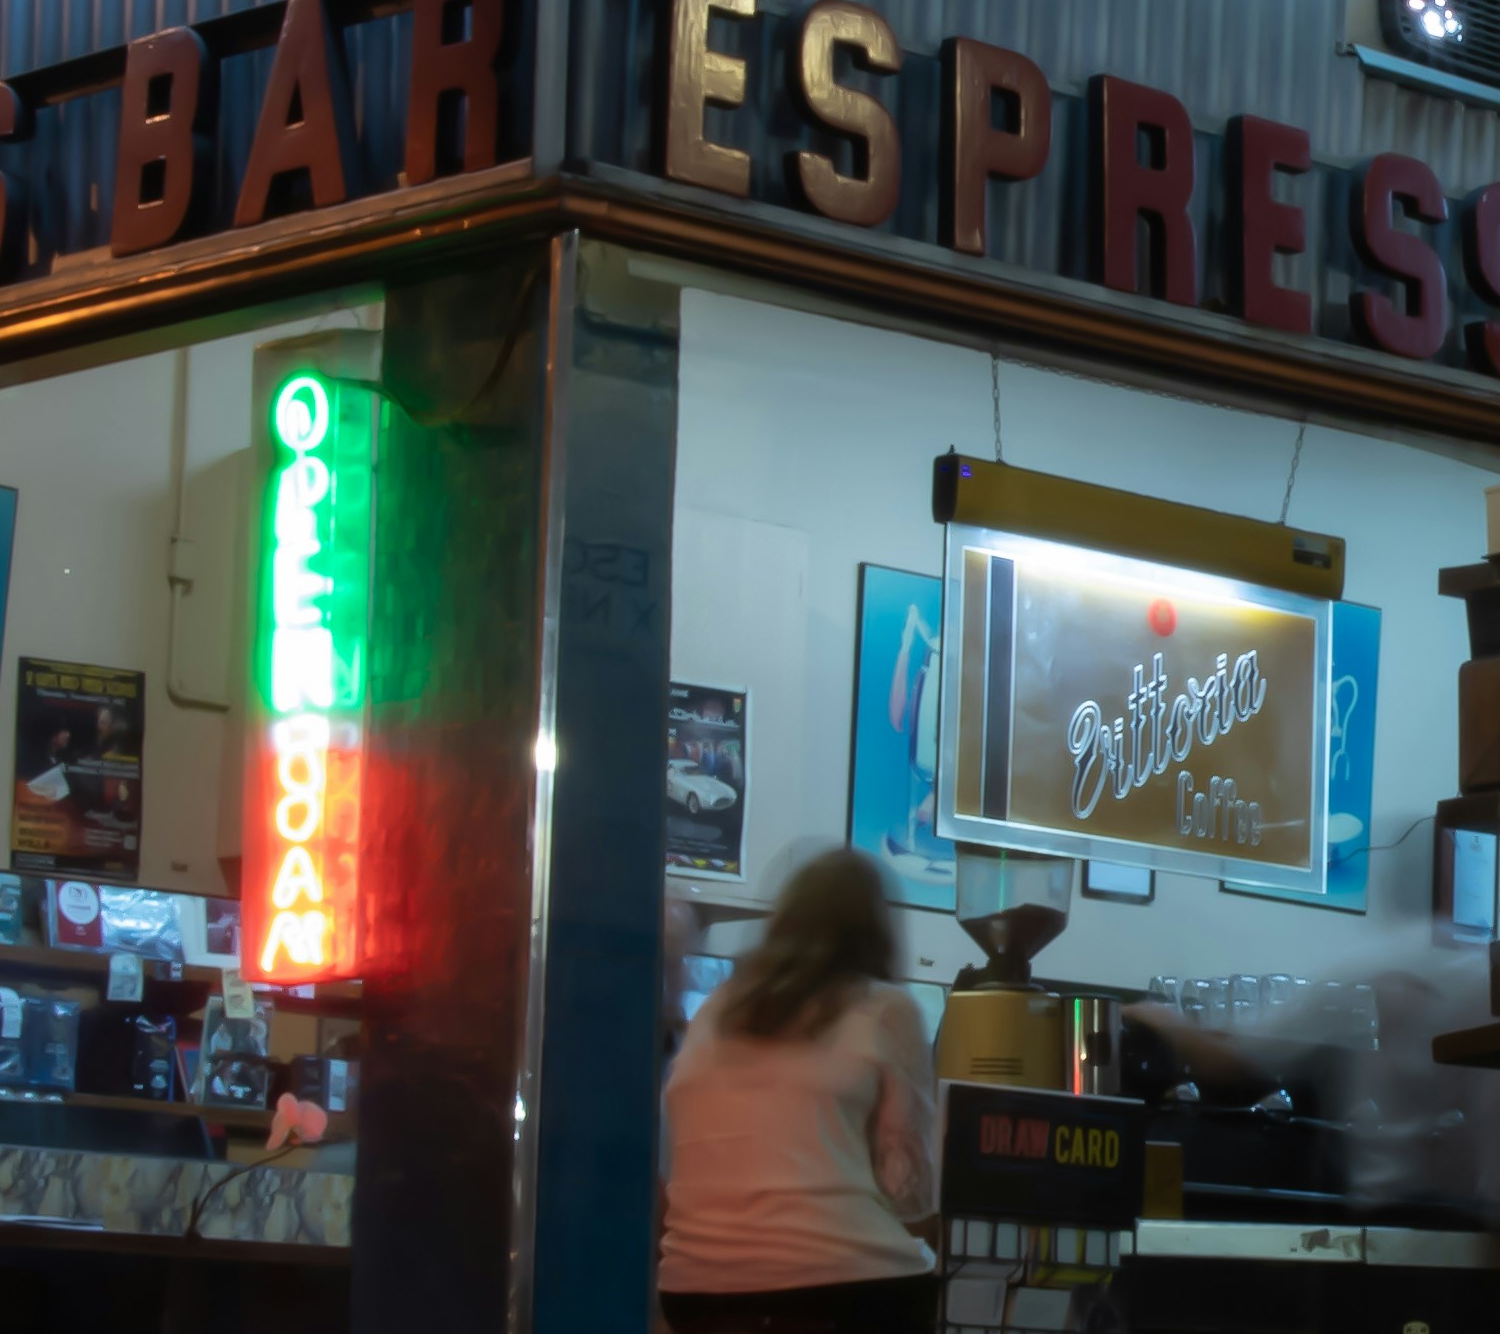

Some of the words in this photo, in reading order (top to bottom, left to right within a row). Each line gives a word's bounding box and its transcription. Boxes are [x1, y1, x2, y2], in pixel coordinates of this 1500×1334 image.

[1067, 649, 1268, 820] Vittoria
[1177, 769, 1264, 847] Coffee
[979, 1114, 1050, 1160] DRAW
[1054, 1124, 1121, 1169] CARD
